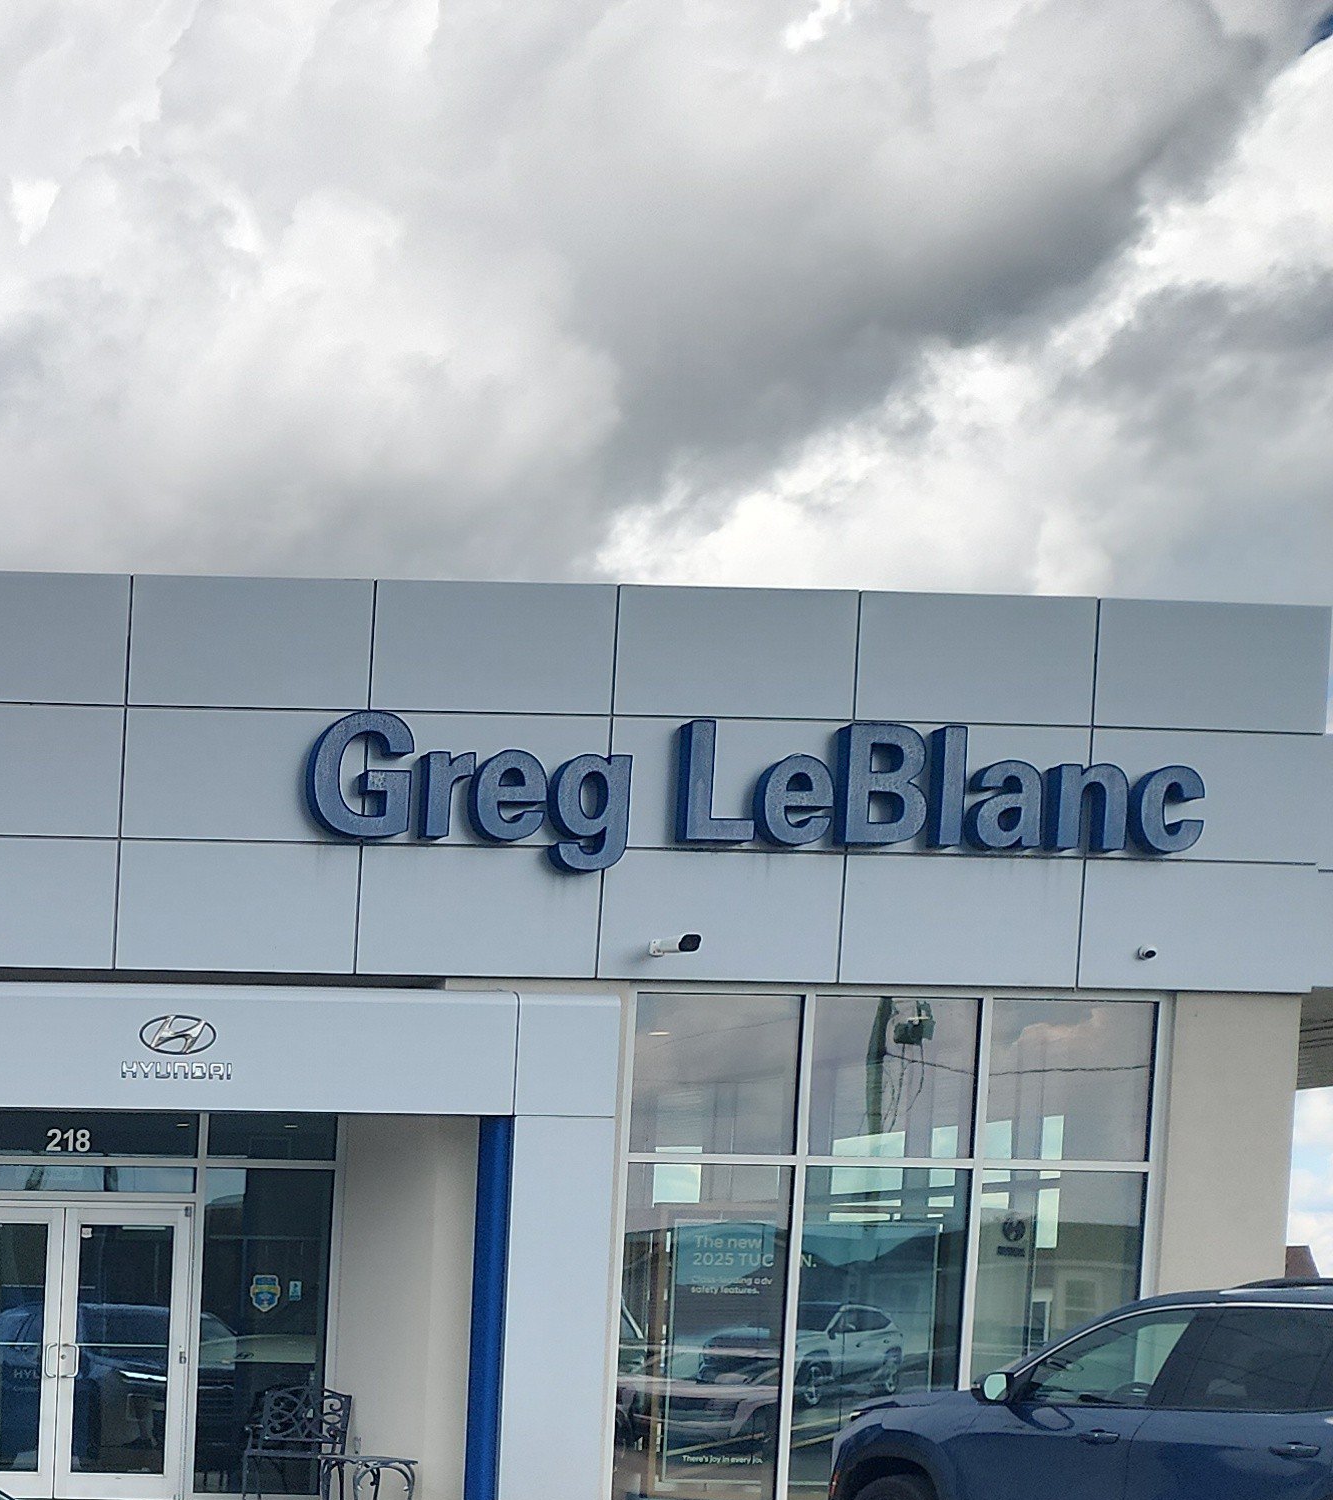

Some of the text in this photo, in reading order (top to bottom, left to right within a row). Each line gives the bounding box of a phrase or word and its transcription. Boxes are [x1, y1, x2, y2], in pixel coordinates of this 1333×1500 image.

[305, 710, 1206, 873] Greg LeBlanc
[120, 1060, 233, 1080] HYUNDAI
[45, 1128, 91, 1152] 218
[694, 1235, 763, 1249] The new
[693, 1252, 817, 1268] 2025 TUCN.
[690, 1286, 719, 1295] safety
[682, 1454, 709, 1463] There's
[709, 1455, 721, 1464] joy
[731, 1456, 751, 1465] every
